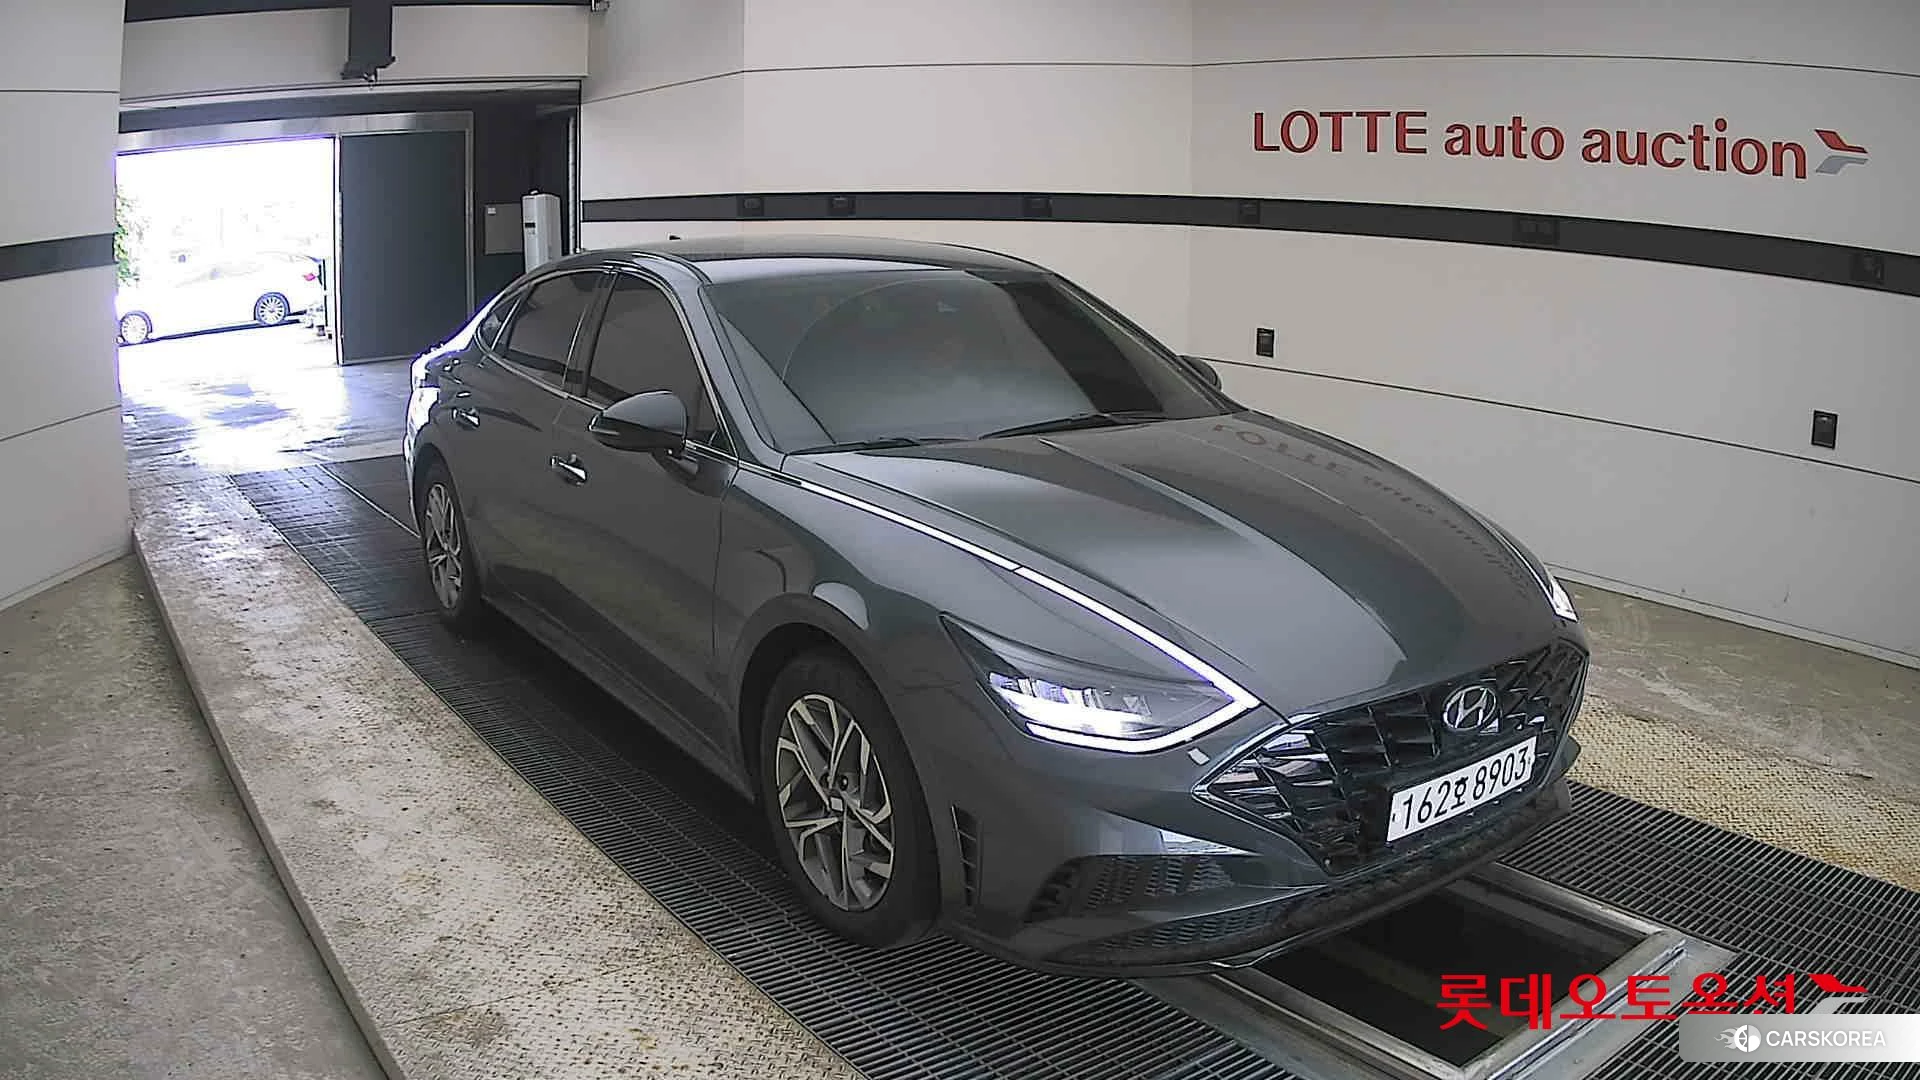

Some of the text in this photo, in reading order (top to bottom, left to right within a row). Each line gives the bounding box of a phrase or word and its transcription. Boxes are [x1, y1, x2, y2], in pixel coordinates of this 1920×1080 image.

[1253, 111, 1808, 180] LOTTE auto auction
